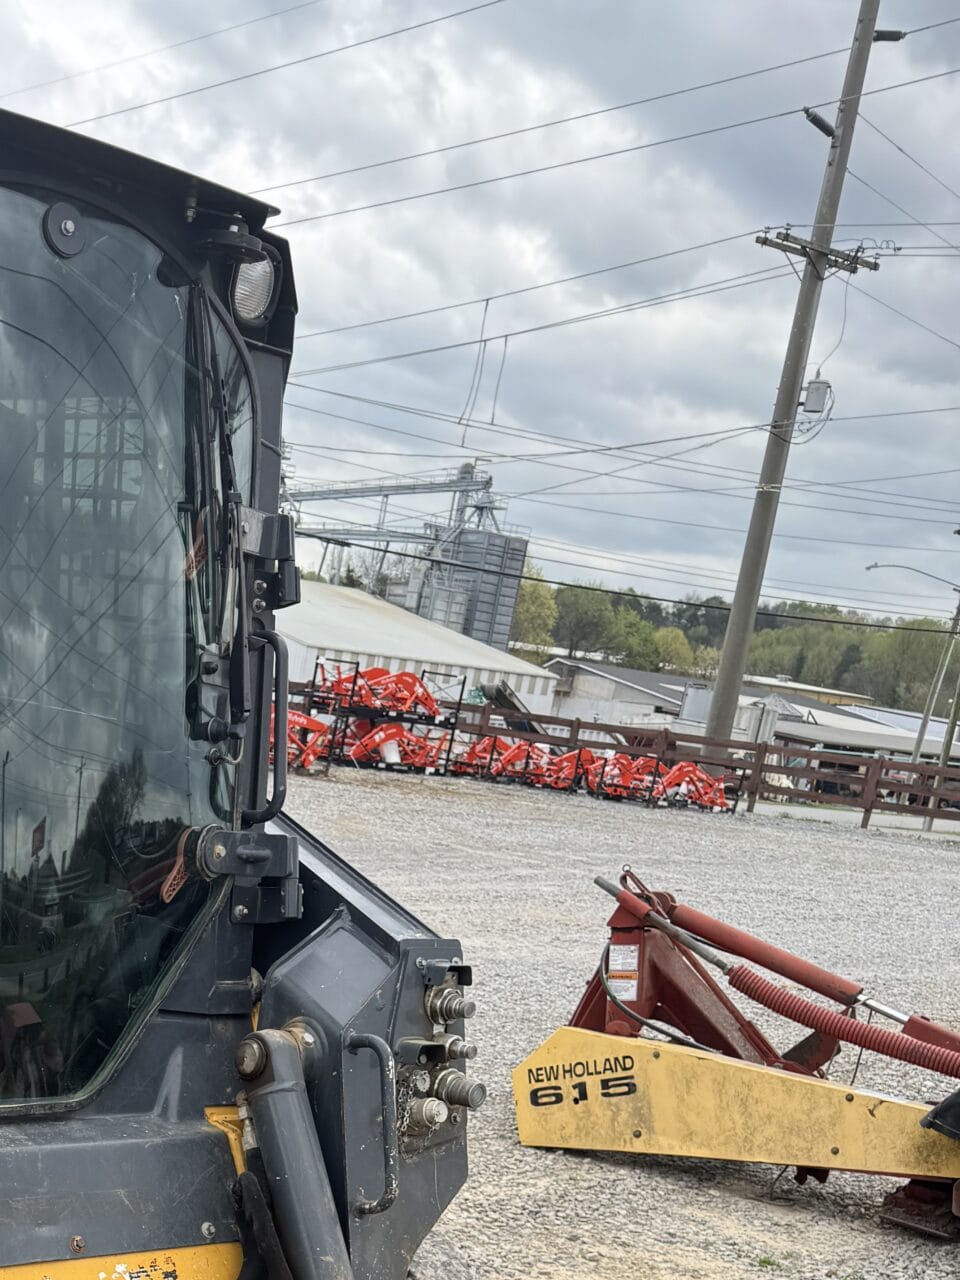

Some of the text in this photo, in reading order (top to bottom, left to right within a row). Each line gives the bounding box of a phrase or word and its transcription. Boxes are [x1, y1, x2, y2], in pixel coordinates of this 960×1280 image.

[527, 1055, 635, 1084] NEW HOLLAND
[529, 1075, 637, 1107] 615
